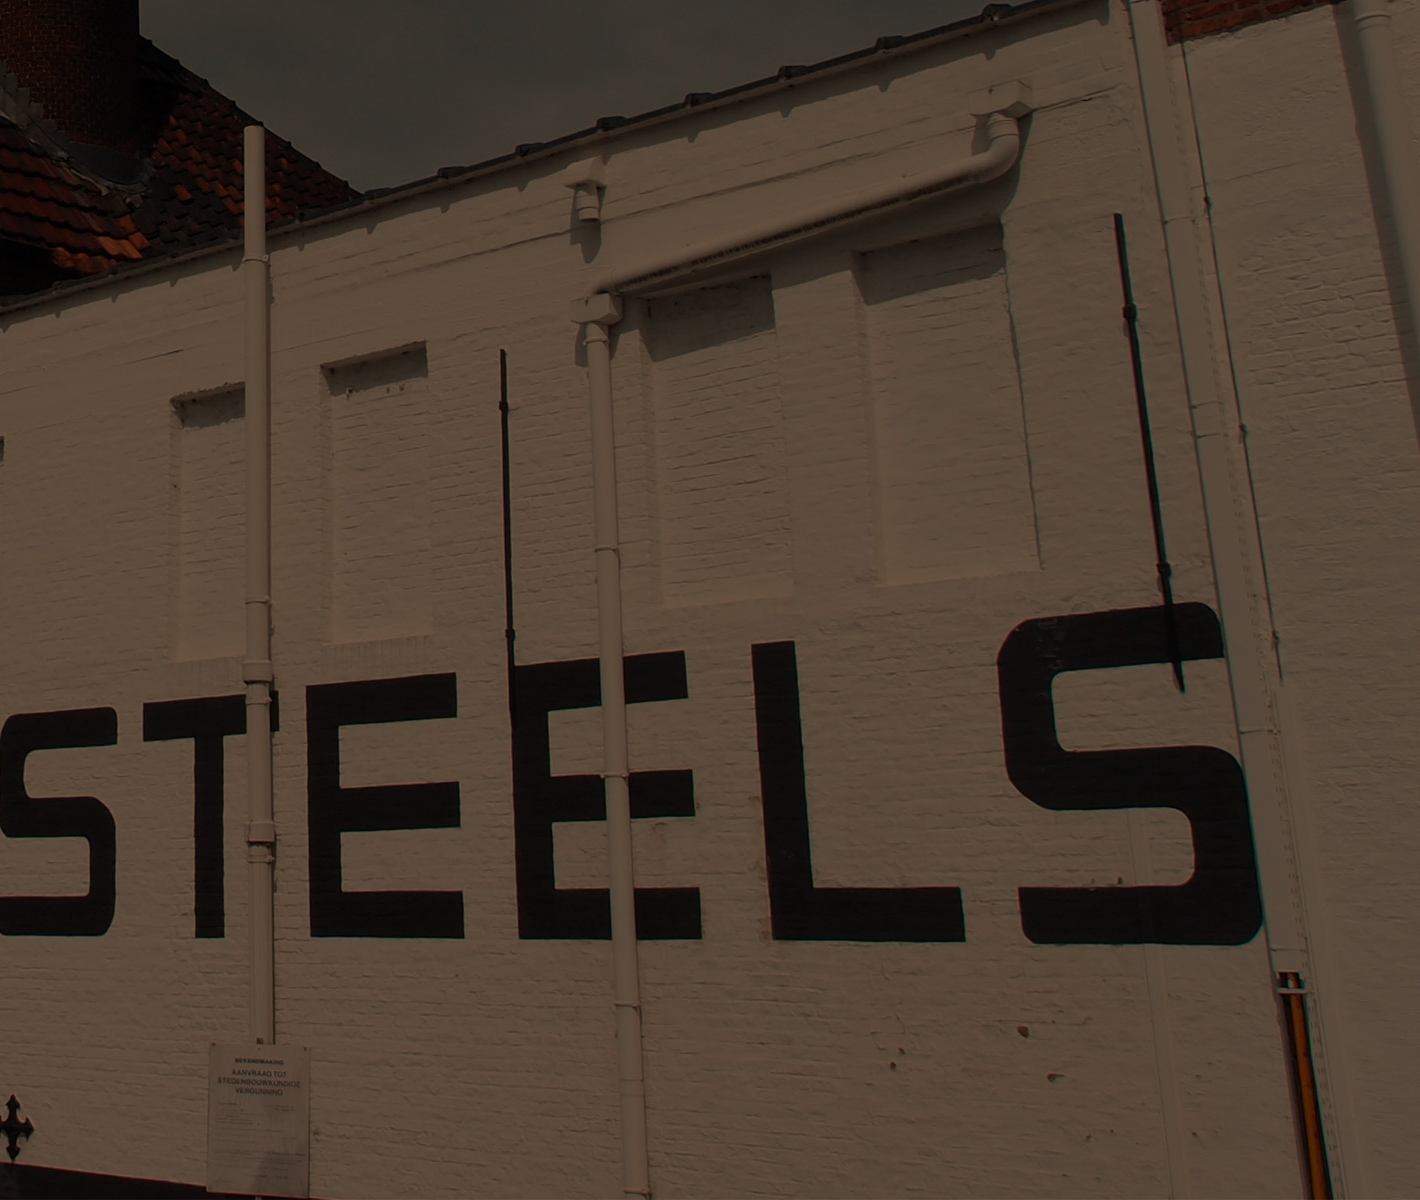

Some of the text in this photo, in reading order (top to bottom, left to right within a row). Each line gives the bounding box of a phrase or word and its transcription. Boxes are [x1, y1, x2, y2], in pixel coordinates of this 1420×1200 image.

[232, 1069, 272, 1077] AANVRAAG
[218, 1077, 301, 1088] STEDENBOUWKUNDIGE
[235, 1088, 283, 1096] VERGUNNING
